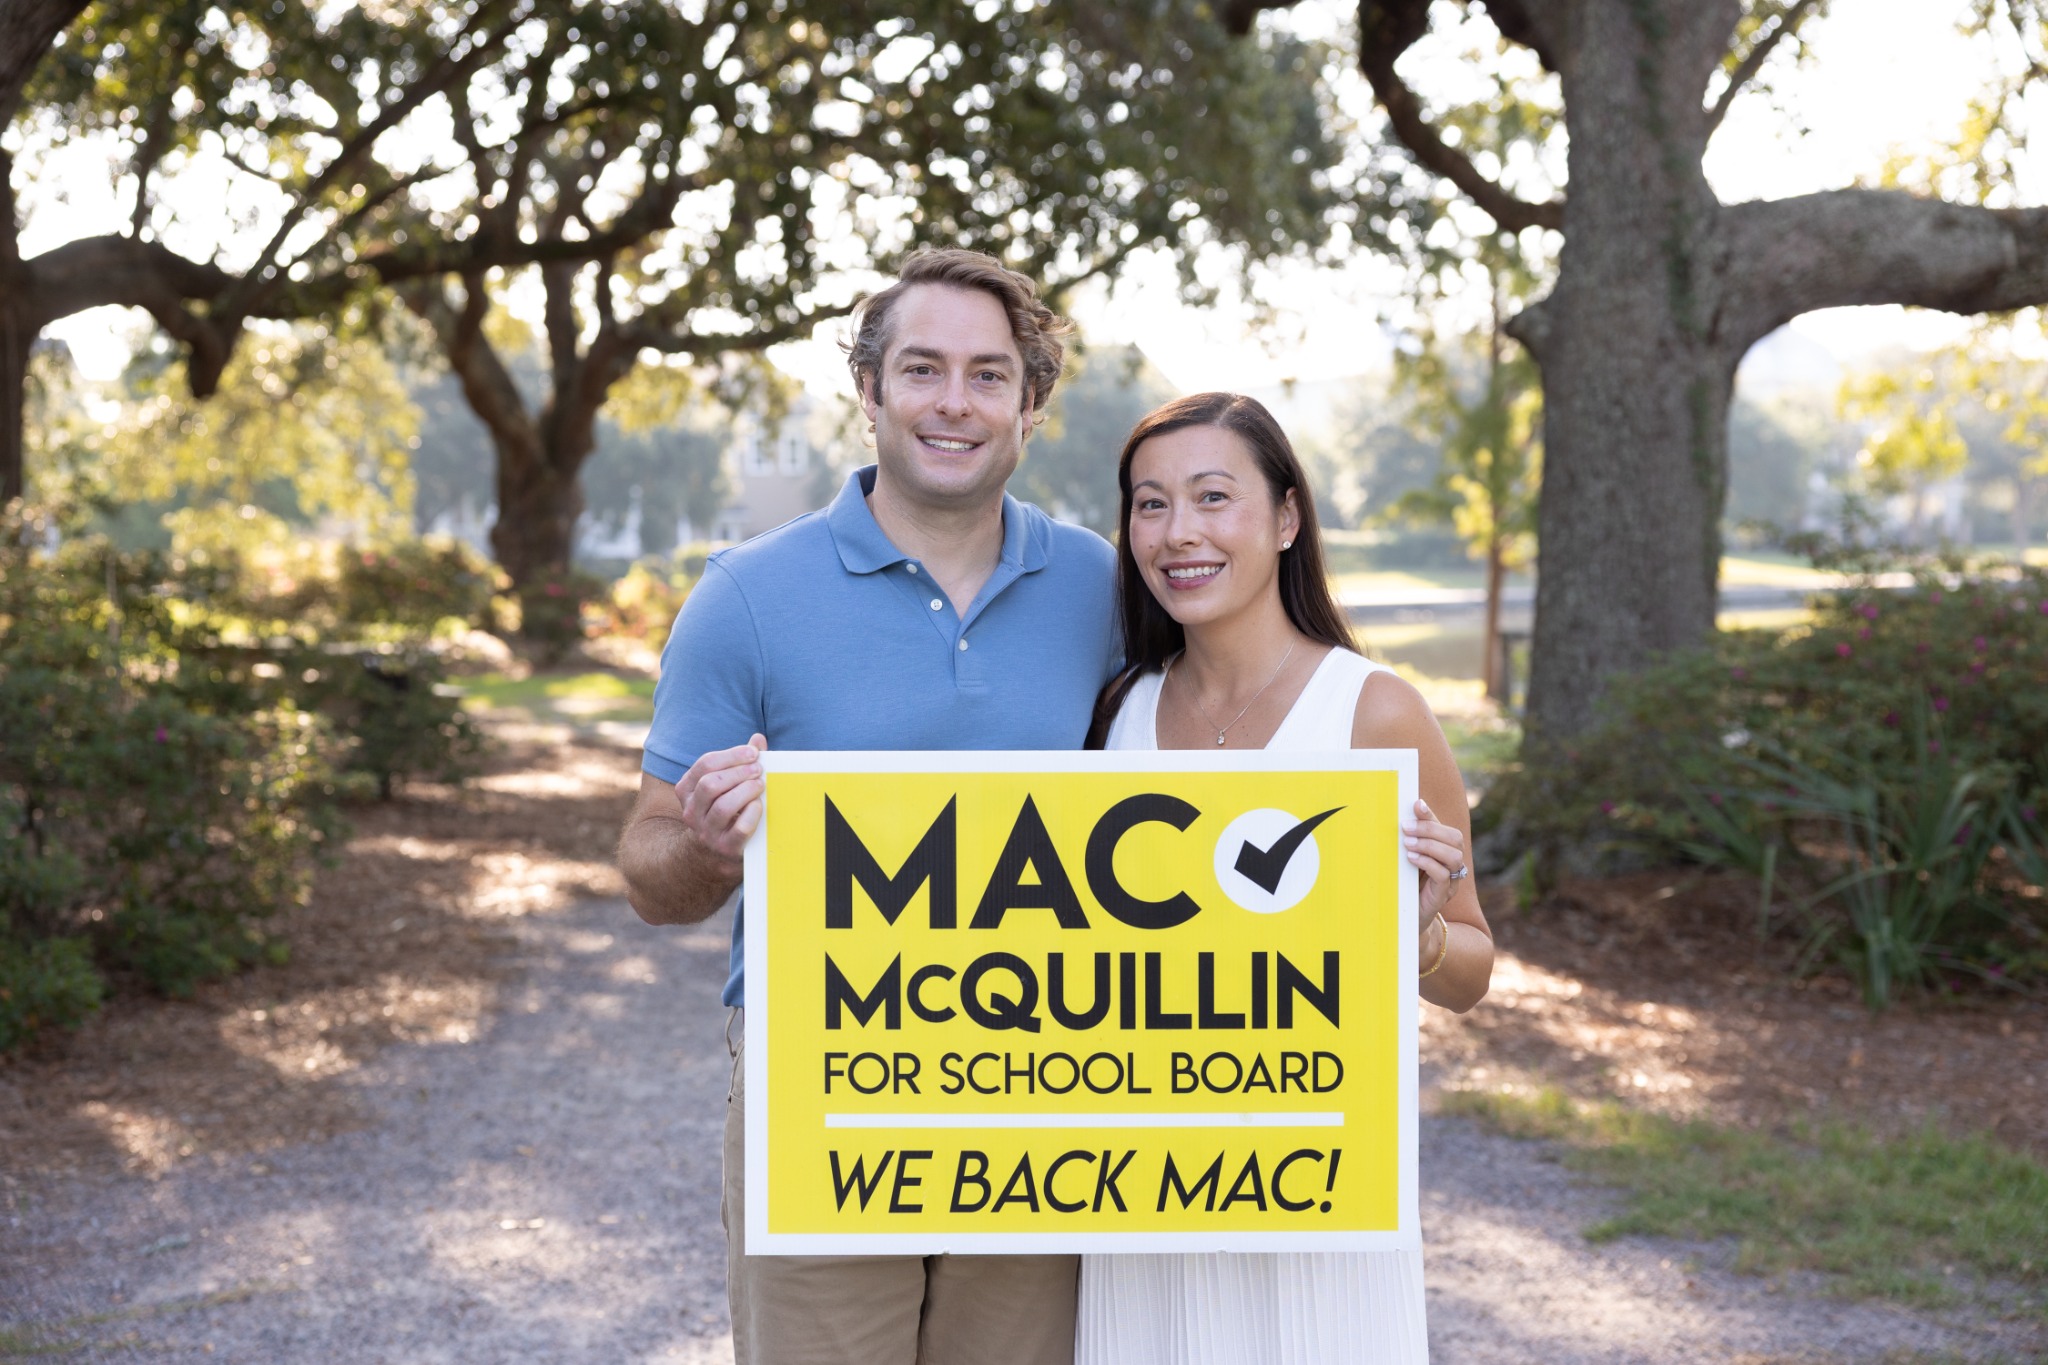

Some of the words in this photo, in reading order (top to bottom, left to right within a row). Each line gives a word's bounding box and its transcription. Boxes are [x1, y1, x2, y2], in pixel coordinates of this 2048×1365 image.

[825, 794, 1201, 929] MAC
[825, 1053, 921, 1094] FOR
[940, 1053, 1152, 1094] SCHOOL
[1172, 1052, 1344, 1094] BOARD
[829, 1151, 934, 1213] WE
[950, 1150, 1136, 1213] BACK
[1157, 1149, 1342, 1213] MAC!
